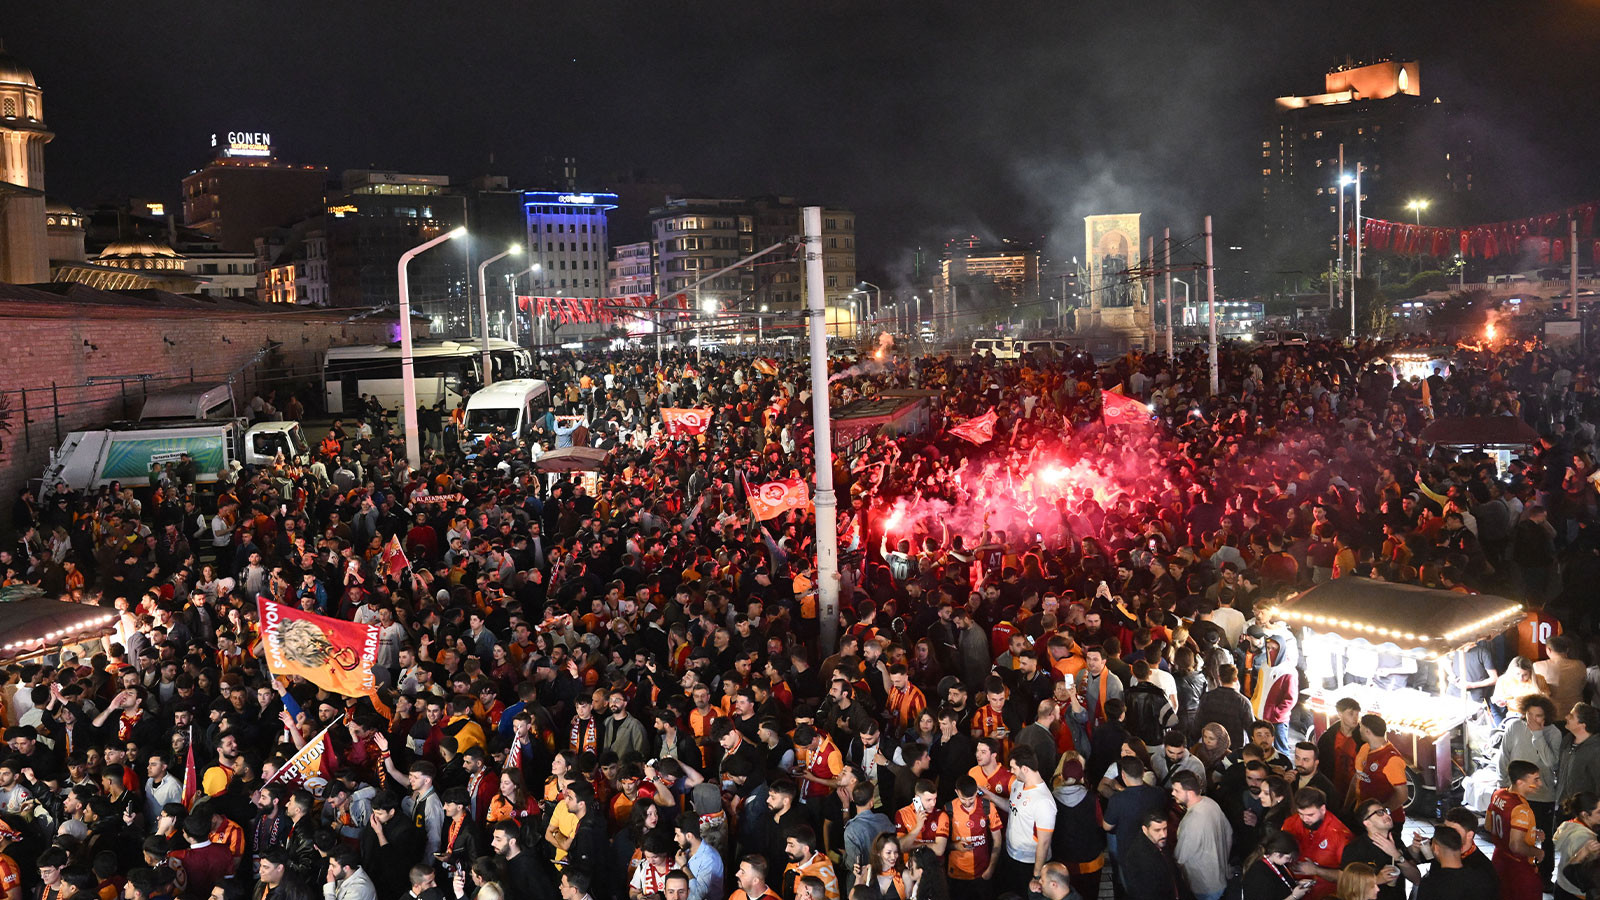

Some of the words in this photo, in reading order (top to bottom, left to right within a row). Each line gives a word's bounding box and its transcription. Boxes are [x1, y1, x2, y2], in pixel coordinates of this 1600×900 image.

[989, 552, 1002, 567] 47
[1530, 621, 1551, 645] 10
[279, 739, 325, 784] MPİYON
[416, 814, 422, 828] C
[1491, 810, 1503, 839] 10
